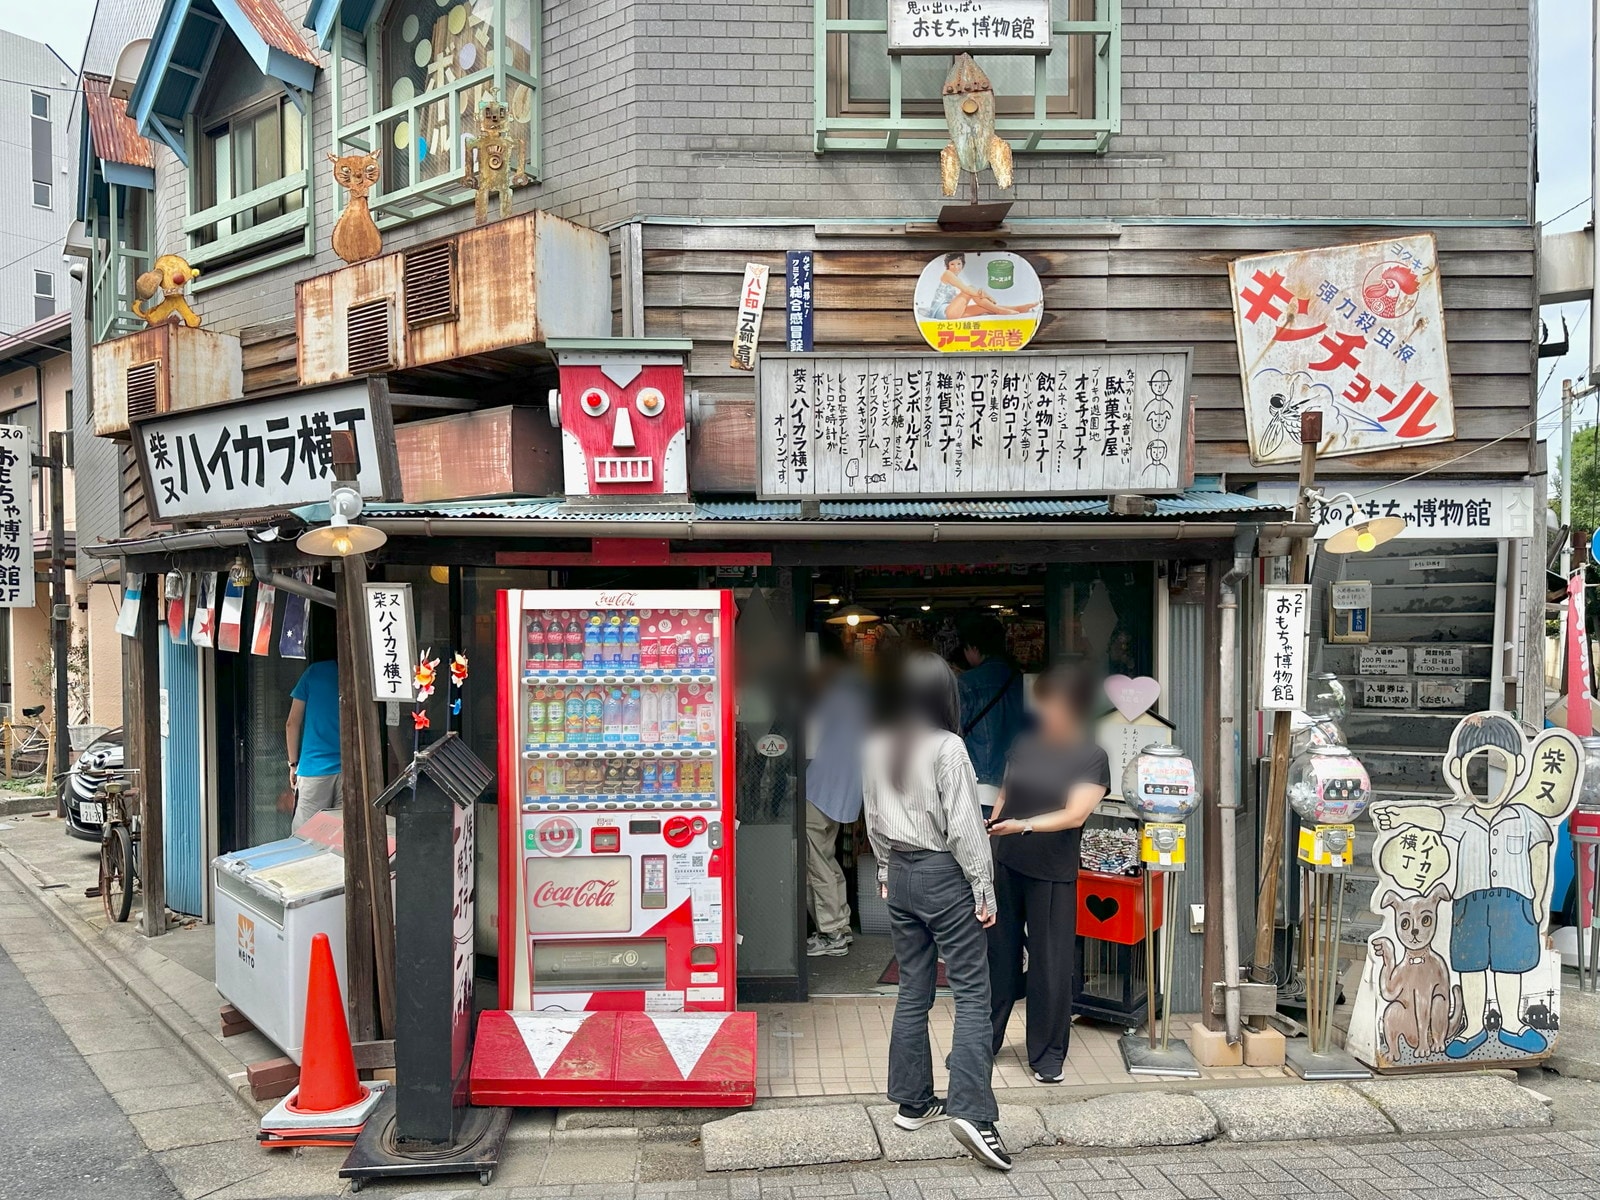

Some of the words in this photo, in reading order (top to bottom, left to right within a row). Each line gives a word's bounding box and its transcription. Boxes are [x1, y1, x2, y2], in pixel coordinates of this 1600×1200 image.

[907, 1, 982, 15] 思い出いっぱい
[912, 15, 1035, 40] おもちゃ博物館
[1391, 242, 1434, 276] ヨクキク
[937, 329, 1023, 348] アース渦巻
[1240, 269, 1439, 438] キンチョール
[1316, 280, 1416, 364] 強力殺虫液
[790, 368, 810, 484] 柴又ハイカラ横丁
[812, 372, 825, 440] ボーンボーン
[825, 373, 838, 452] レトロな時計が
[838, 373, 849, 455] レトロなテレビに
[857, 374, 869, 459] アイスキャンデー
[869, 373, 880, 449] アイスクリーム
[904, 369, 921, 471] ピンボールゲーム
[937, 372, 955, 464] 雑貨コーナー
[970, 373, 988, 450] ブロマイド
[988, 369, 999, 422] スター集合
[1003, 373, 1021, 459] 射的コーナー
[1020, 372, 1033, 462] バーンバーン大当り
[1036, 371, 1055, 473] 飲み物コーナー
[1073, 373, 1089, 470] オモチャコーナー
[1089, 367, 1101, 442] ブリキの遊園地
[1101, 376, 1125, 457] 駄菓子屋
[150, 431, 180, 504] 柴又
[1294, 594, 1302, 618] 2F
[379, 611, 402, 694] ハイカラ横丁
[1272, 595, 1294, 702] おもちゃ博物館
[1366, 695, 1409, 703] お買い求め
[1535, 748, 1565, 804] 柴又
[1400, 833, 1418, 870] 横丁
[1414, 835, 1439, 890] ハイカラ
[533, 879, 620, 908] Coca-Cola
